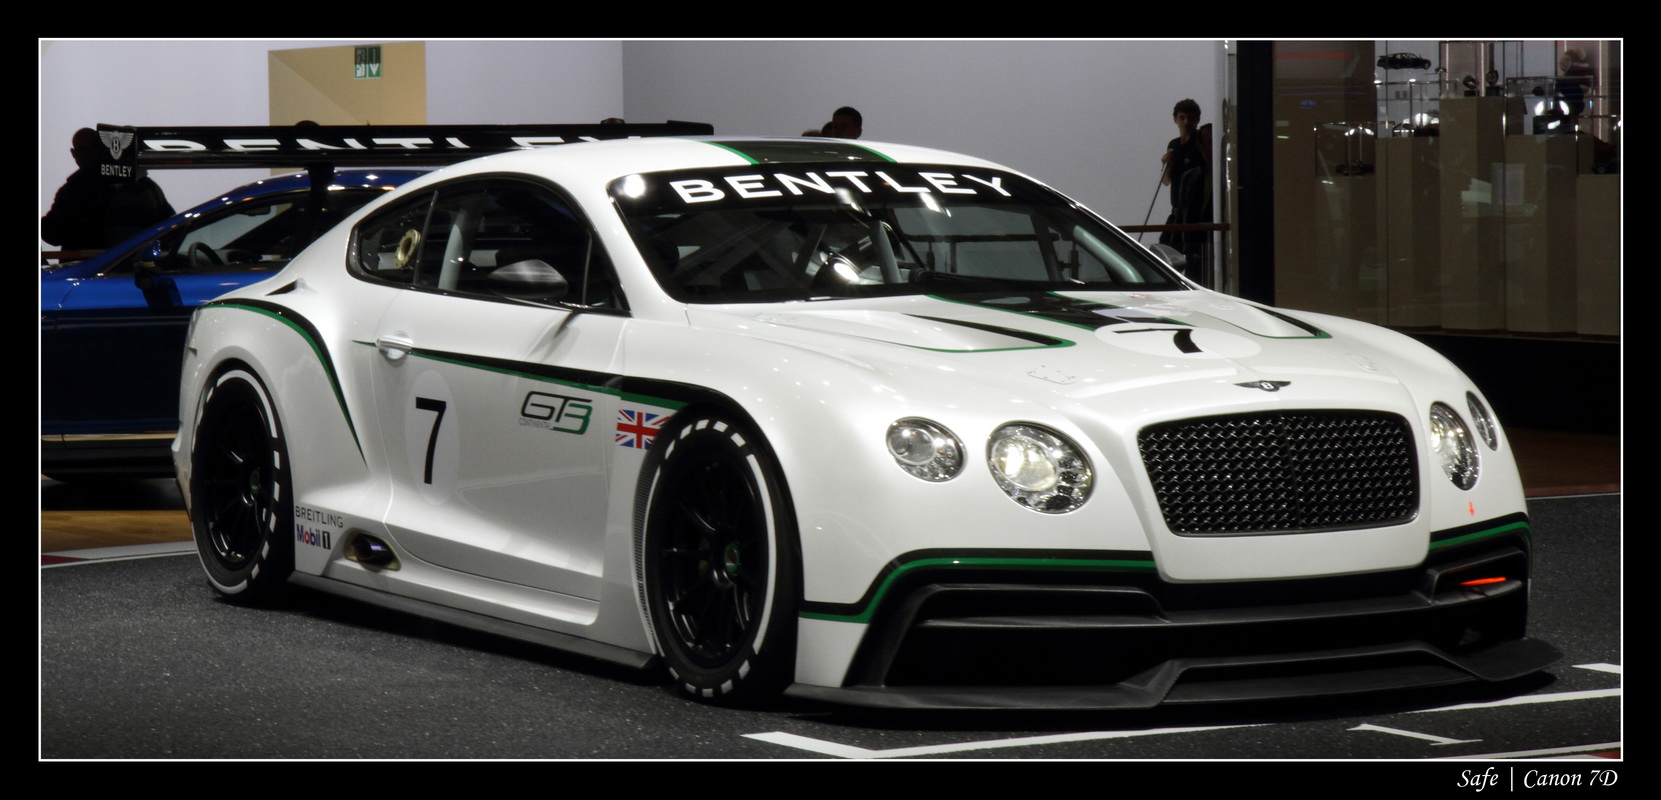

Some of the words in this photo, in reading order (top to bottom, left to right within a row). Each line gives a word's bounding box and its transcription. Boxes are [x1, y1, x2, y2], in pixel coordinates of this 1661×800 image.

[100, 164, 132, 178] BENTLEY
[670, 171, 1012, 204] BENTLEY
[1112, 328, 1204, 354] 7
[520, 390, 593, 435] GT3
[415, 396, 447, 485] 7
[295, 505, 344, 529] BREITLING
[296, 523, 321, 548] Mobil
[322, 530, 331, 551] 1
